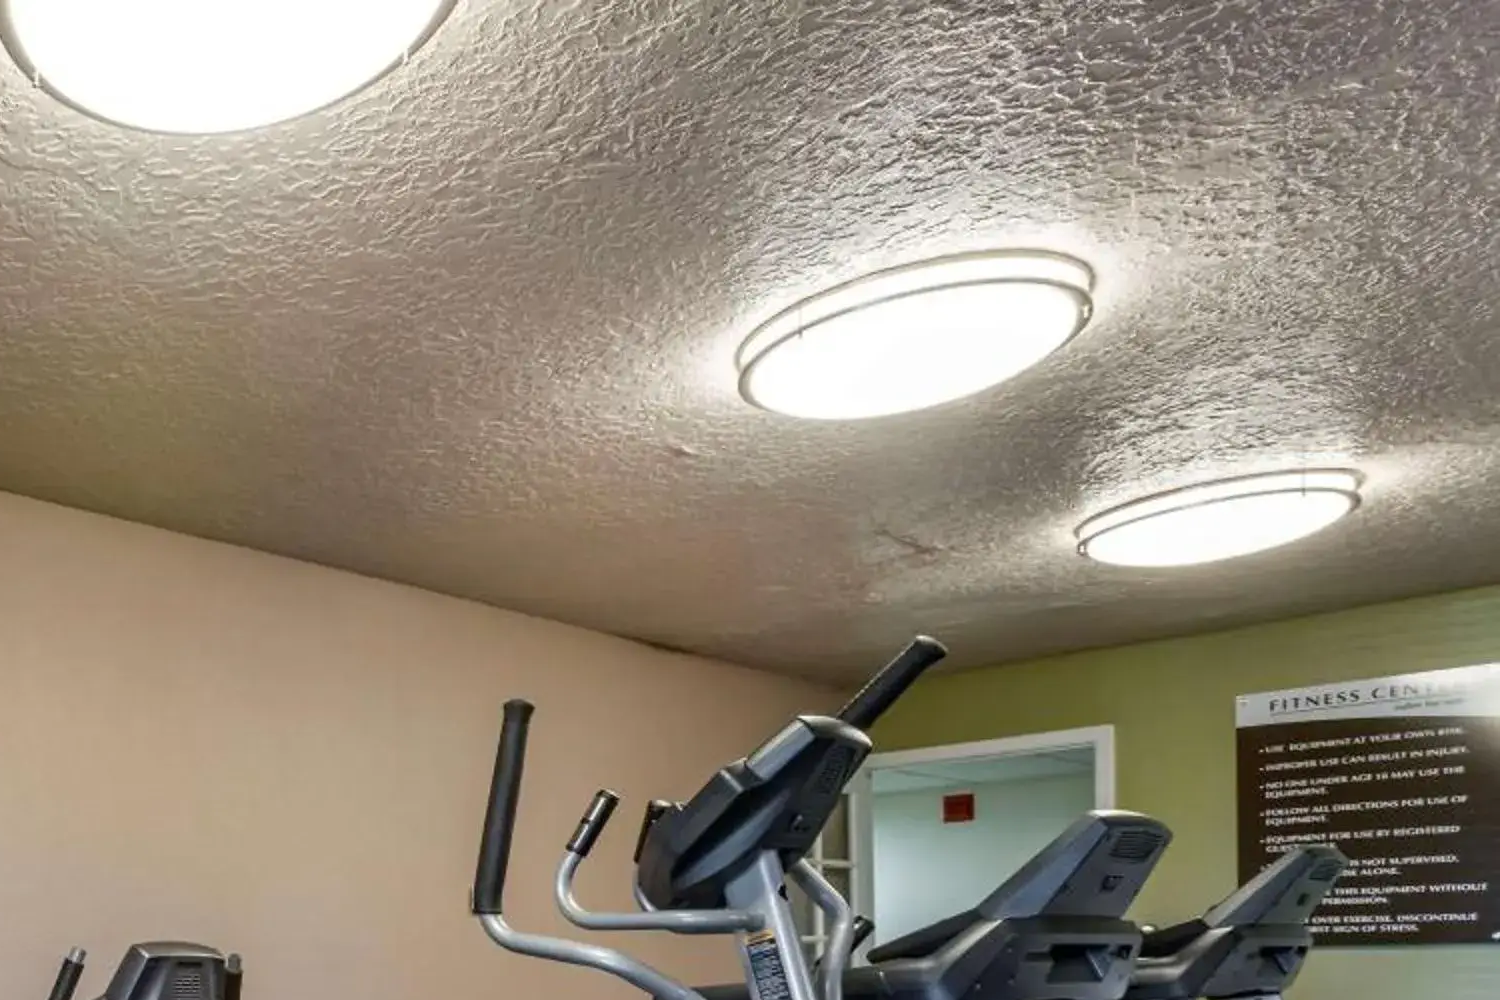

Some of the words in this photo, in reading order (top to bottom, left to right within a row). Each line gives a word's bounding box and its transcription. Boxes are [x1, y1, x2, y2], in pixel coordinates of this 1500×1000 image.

[1269, 689, 1360, 713] FITNESS
[1371, 682, 1468, 700] CENT
[1289, 737, 1350, 751] EQUIPMENT
[1353, 736, 1366, 745] AT
[1369, 733, 1401, 743] YOUR
[1404, 730, 1436, 740] OWN
[1265, 759, 1317, 771] IMPROPER
[1320, 757, 1339, 767] USE
[1341, 755, 1365, 765] CAN
[1368, 751, 1406, 763] RESULT
[1410, 750, 1423, 759] IN
[1266, 781, 1283, 790] NO
[1285, 779, 1307, 788] ONE
[1310, 775, 1348, 786] UNDER
[1351, 773, 1373, 783] AGE
[1391, 769, 1416, 779] MAY
[1419, 767, 1440, 777] USE
[1443, 765, 1465, 775] THE
[1266, 807, 1309, 817] FOLLOW
[1312, 805, 1330, 814] ALL
[1332, 800, 1399, 812] DIRECTIONS
[1402, 798, 1425, 807] FOR
[1427, 796, 1449, 805] USE
[1451, 795, 1468, 804] OF
[1266, 832, 1326, 845] EQUIPMENT
[1329, 831, 1350, 840] FOR
[1353, 829, 1374, 839] USE
[1376, 828, 1390, 838] BY
[1393, 825, 1461, 837] REGISTERED
[1362, 857, 1386, 867] NOT
[1389, 855, 1460, 866] SUPERVISED.
[1361, 867, 1401, 876] ALONE.
[1335, 887, 1360, 896] THIS
[1361, 884, 1426, 895] EQUIPMENT
[1429, 882, 1488, 892] WITHOUT
[1311, 915, 1341, 924] OVER
[1397, 912, 1478, 923] DISCONTINUE
[1332, 925, 1359, 934] SIGN
[1361, 924, 1377, 933] OF
